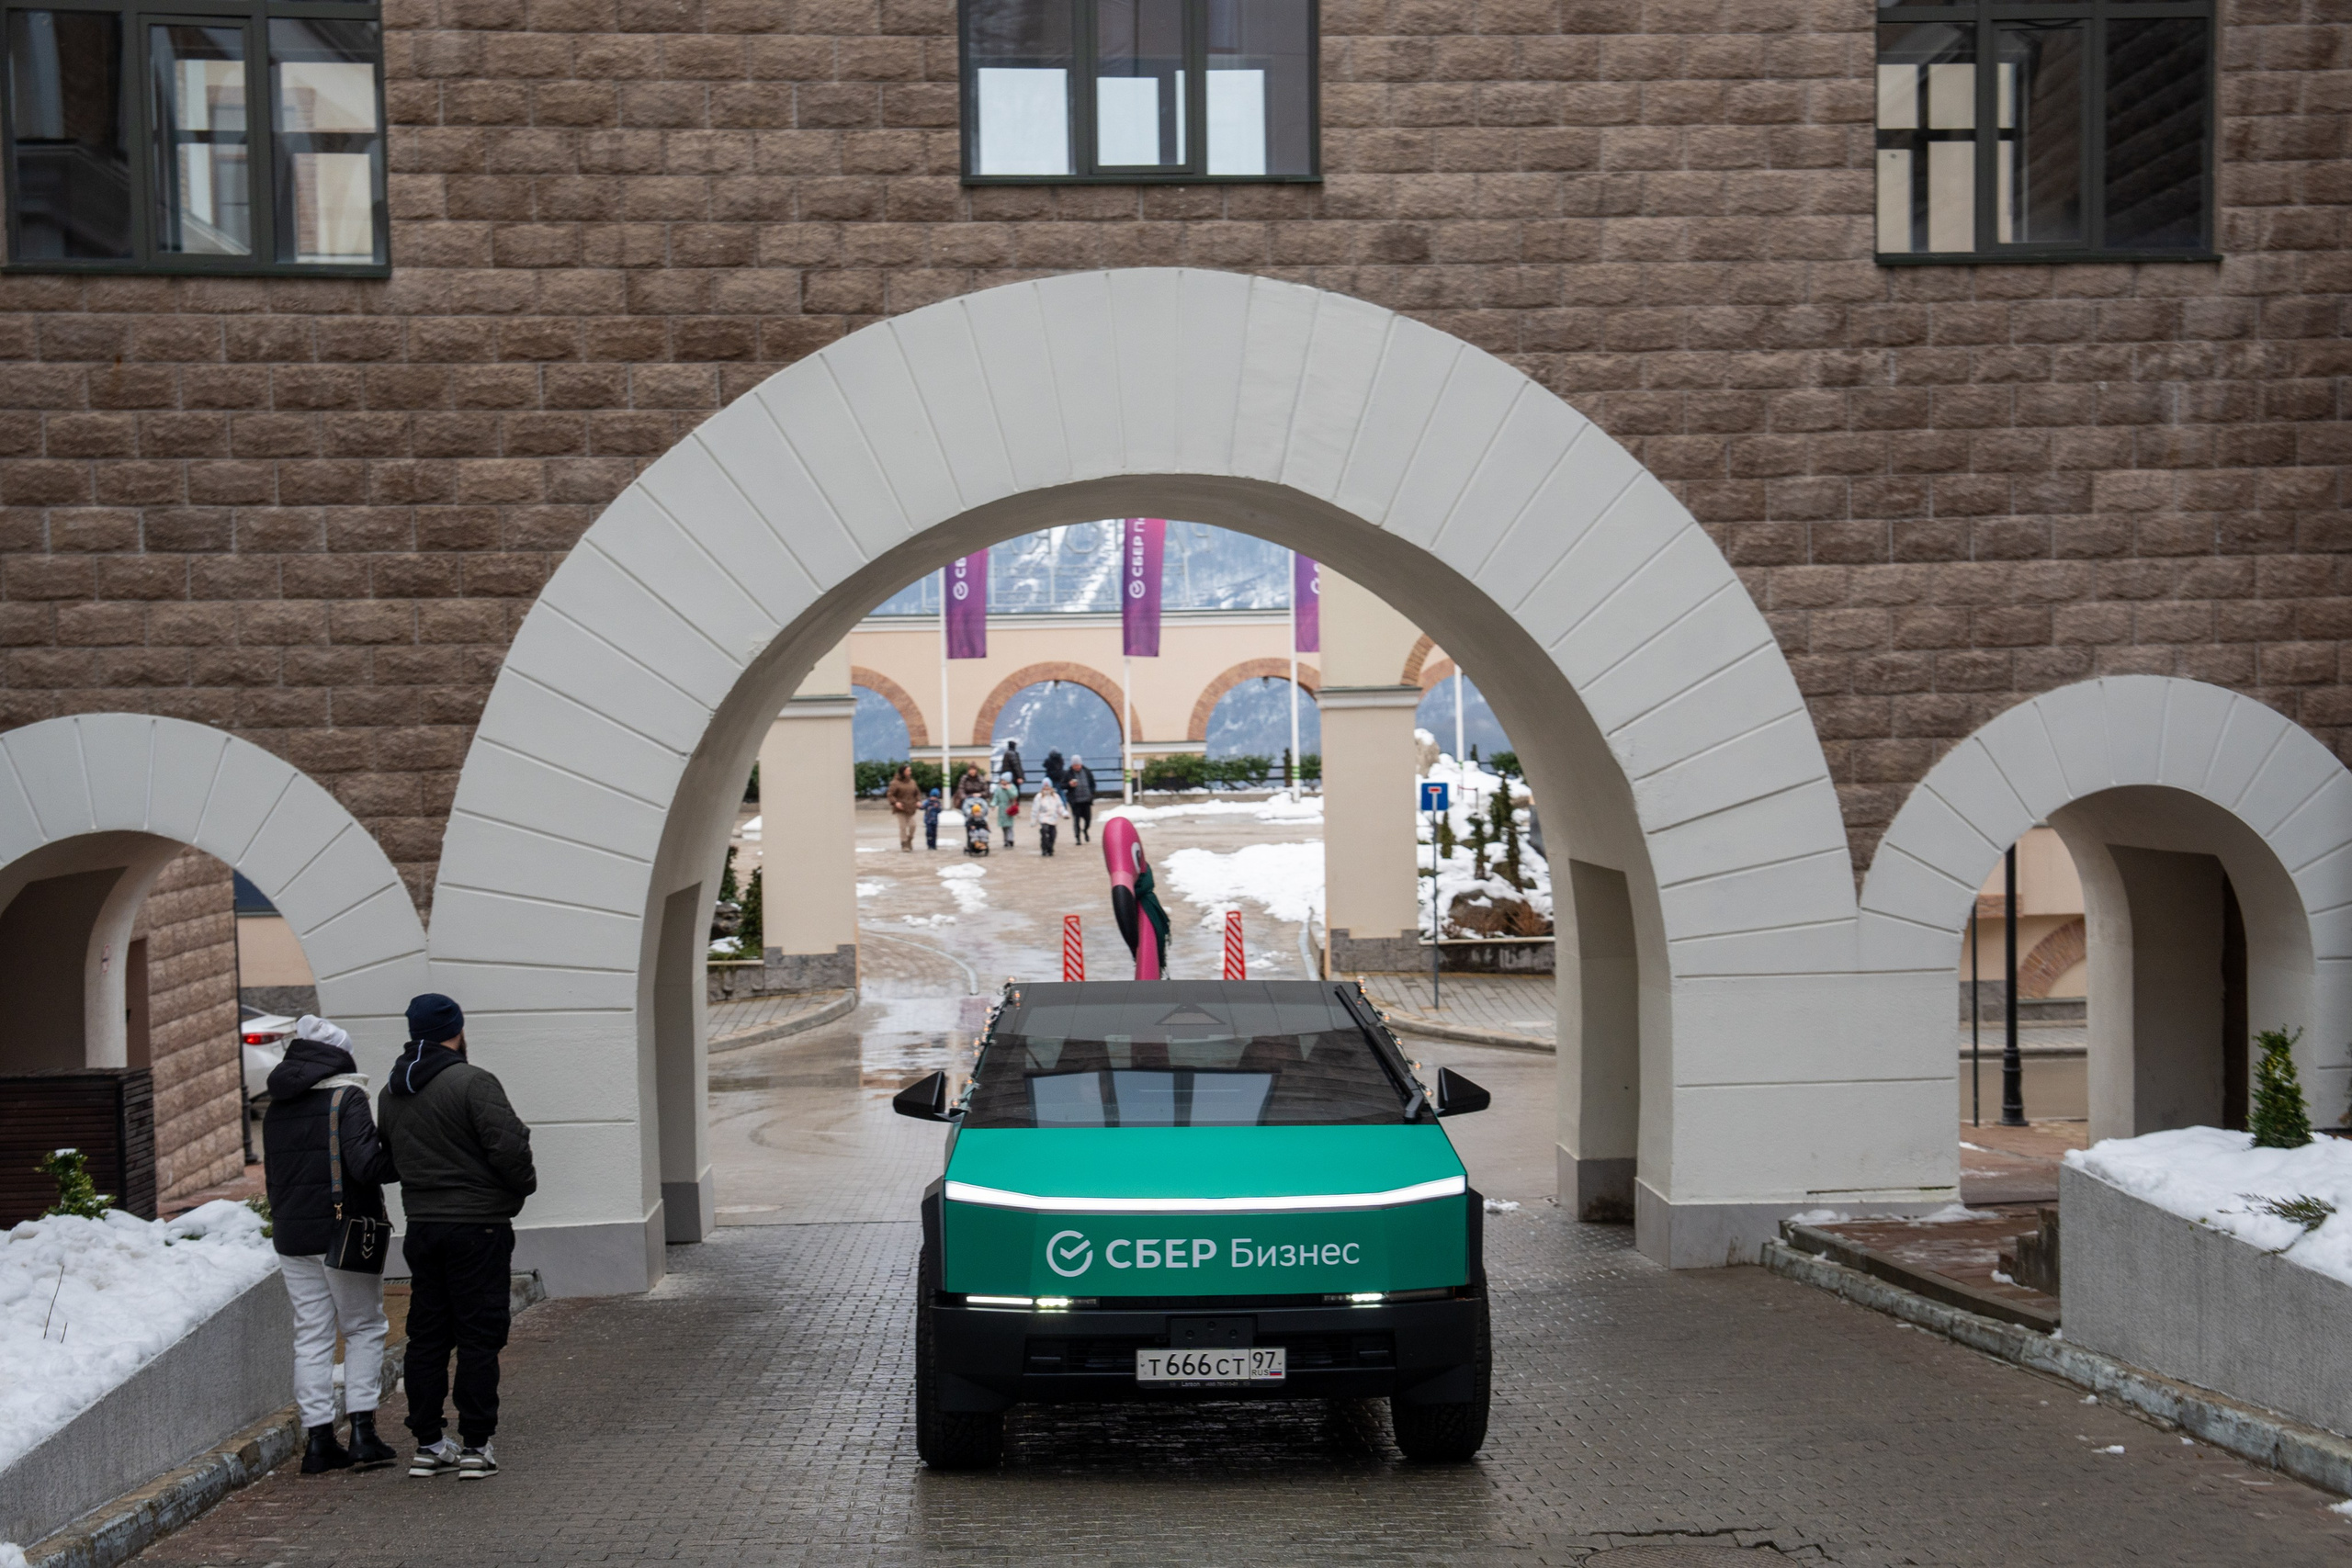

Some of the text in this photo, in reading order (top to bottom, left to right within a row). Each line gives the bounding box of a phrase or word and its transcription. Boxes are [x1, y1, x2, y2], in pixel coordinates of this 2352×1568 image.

[1132, 536, 1145, 577] СБЕР
[1105, 1237, 1361, 1269] СБЕР Бизнес
[1252, 1351, 1276, 1369] 97
